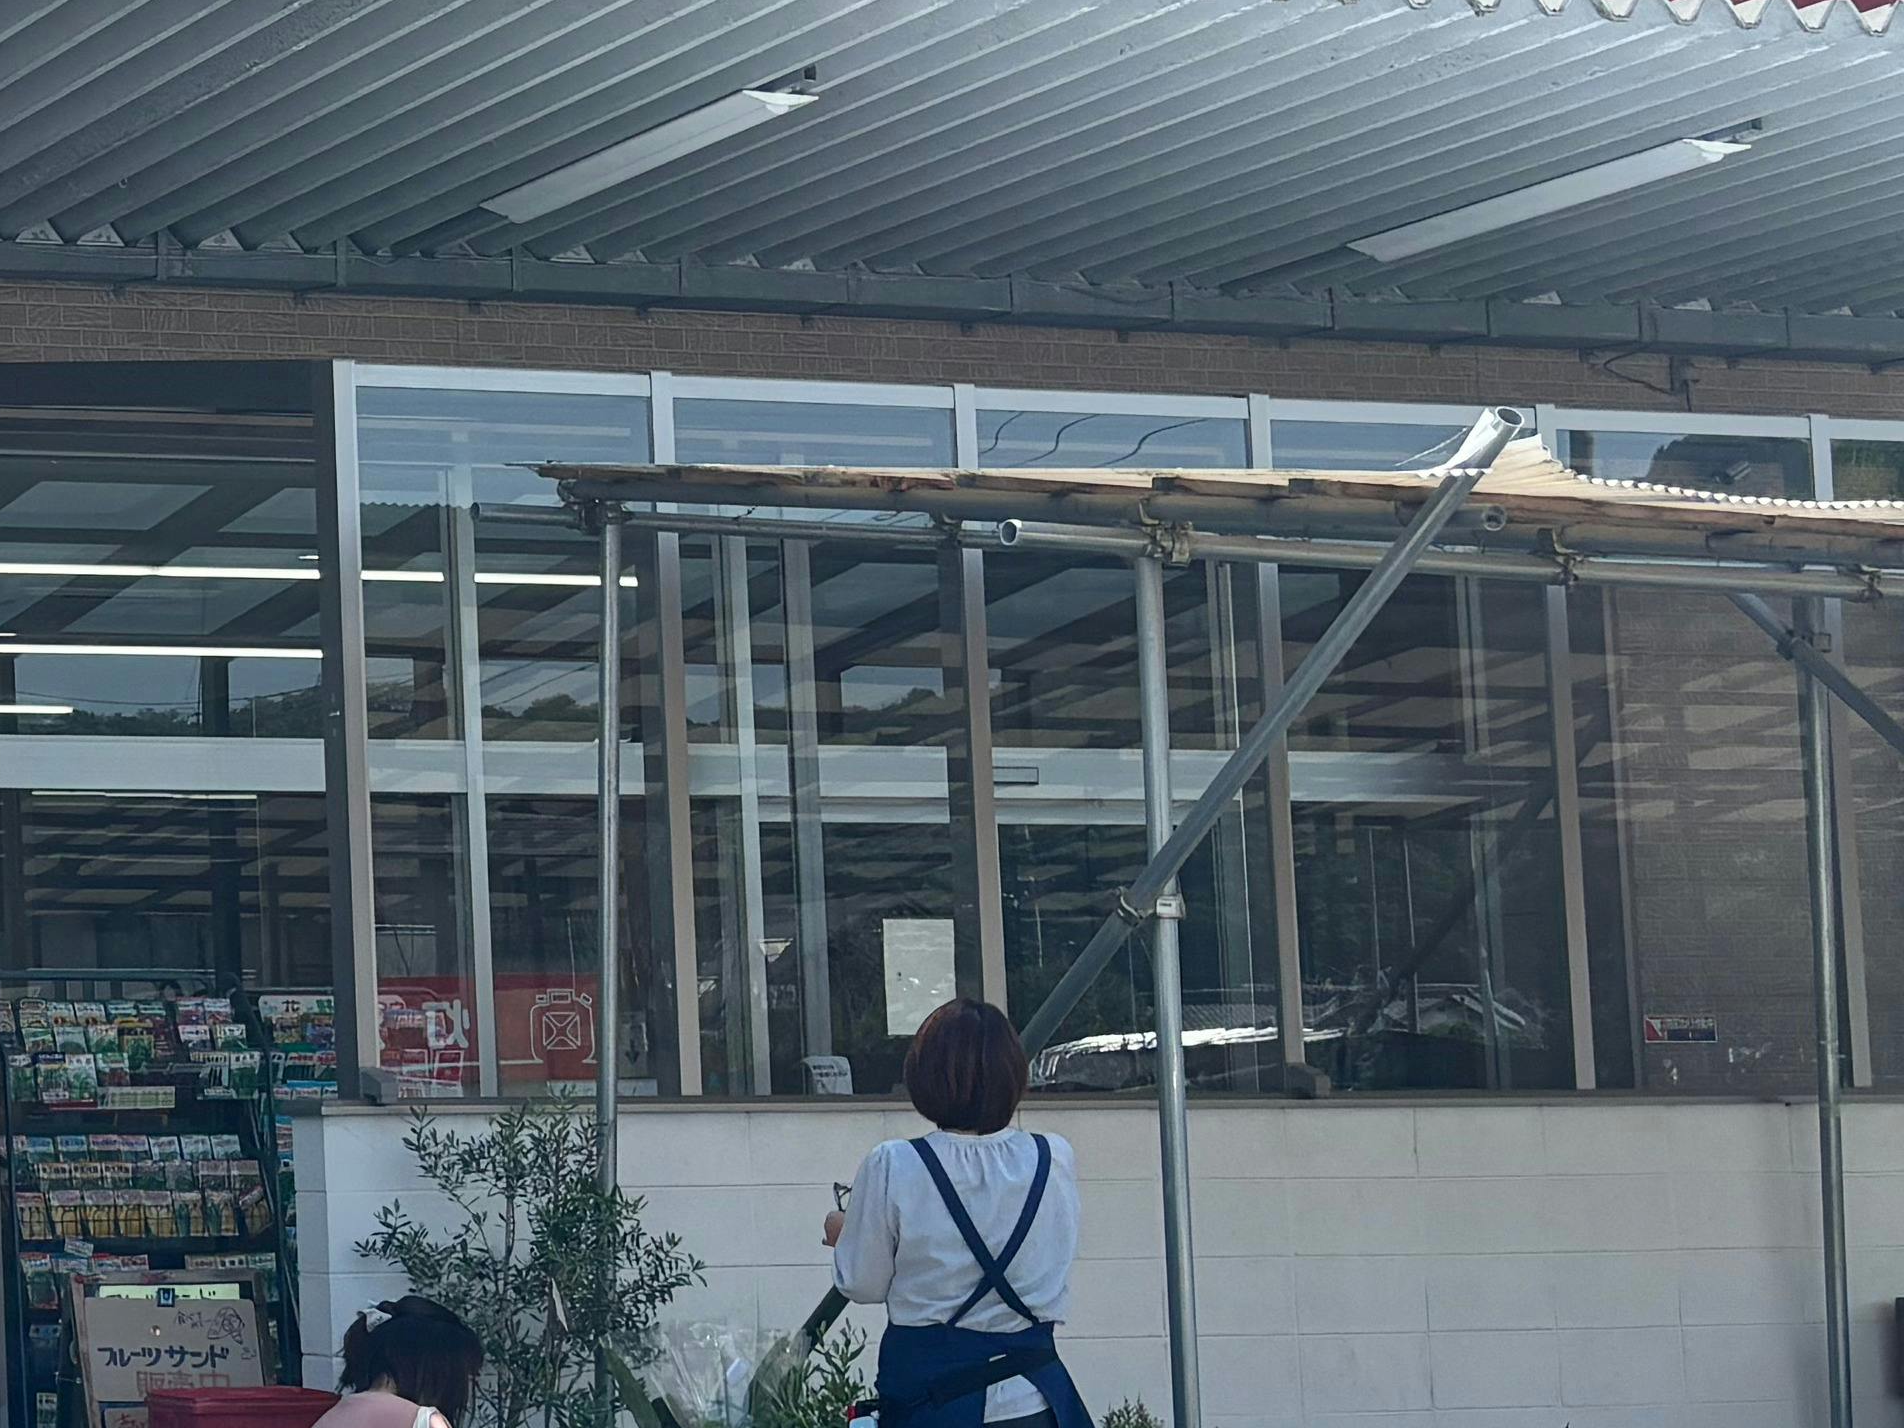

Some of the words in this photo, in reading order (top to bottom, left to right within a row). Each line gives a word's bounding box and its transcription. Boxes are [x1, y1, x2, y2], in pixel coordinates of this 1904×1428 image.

[97, 1344, 230, 1369] フルーツサンド
